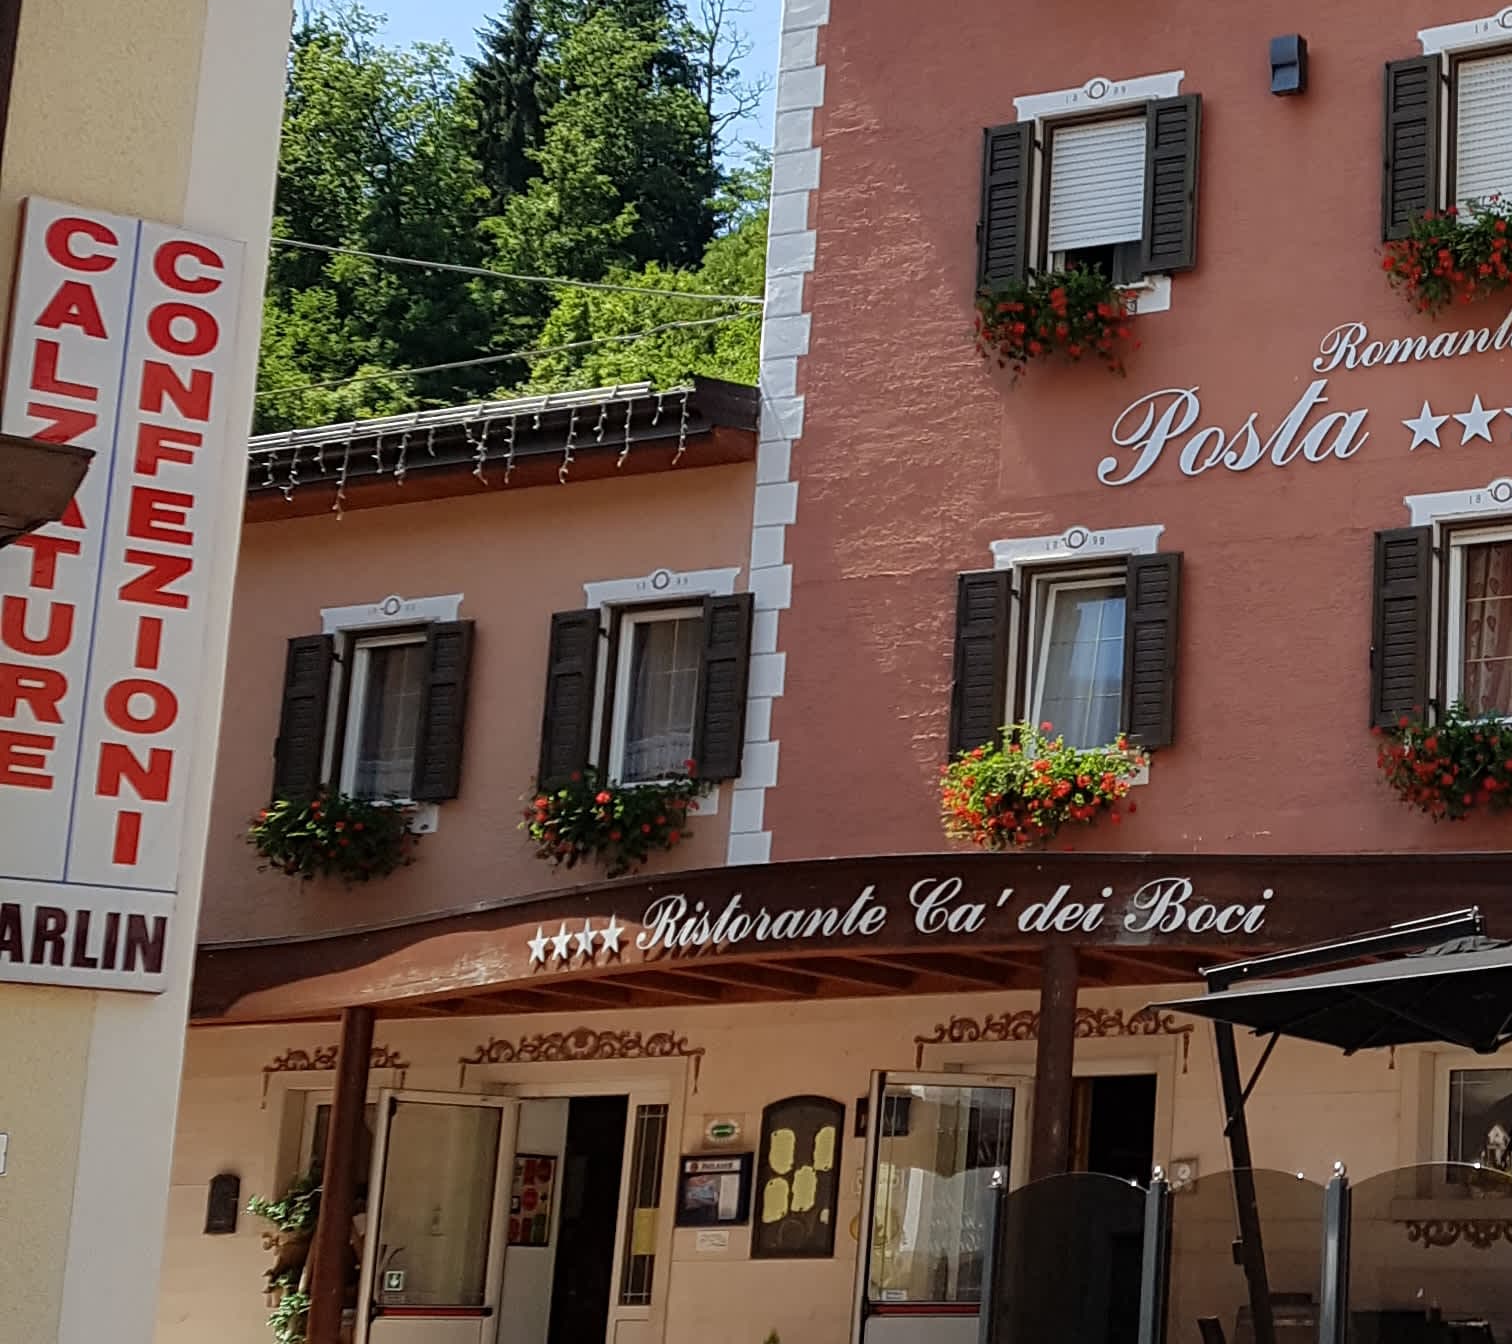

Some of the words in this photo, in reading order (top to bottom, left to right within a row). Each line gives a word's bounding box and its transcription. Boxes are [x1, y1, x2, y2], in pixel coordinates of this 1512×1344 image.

[0, 217, 119, 789] CALZTURE
[95, 240, 224, 865] CONFEZIONI
[1097, 378, 1369, 486] Posta
[636, 884, 887, 950] Ristorante
[908, 877, 1010, 934] Ca'
[1017, 884, 1113, 932] dei
[1124, 876, 1273, 934] Boci
